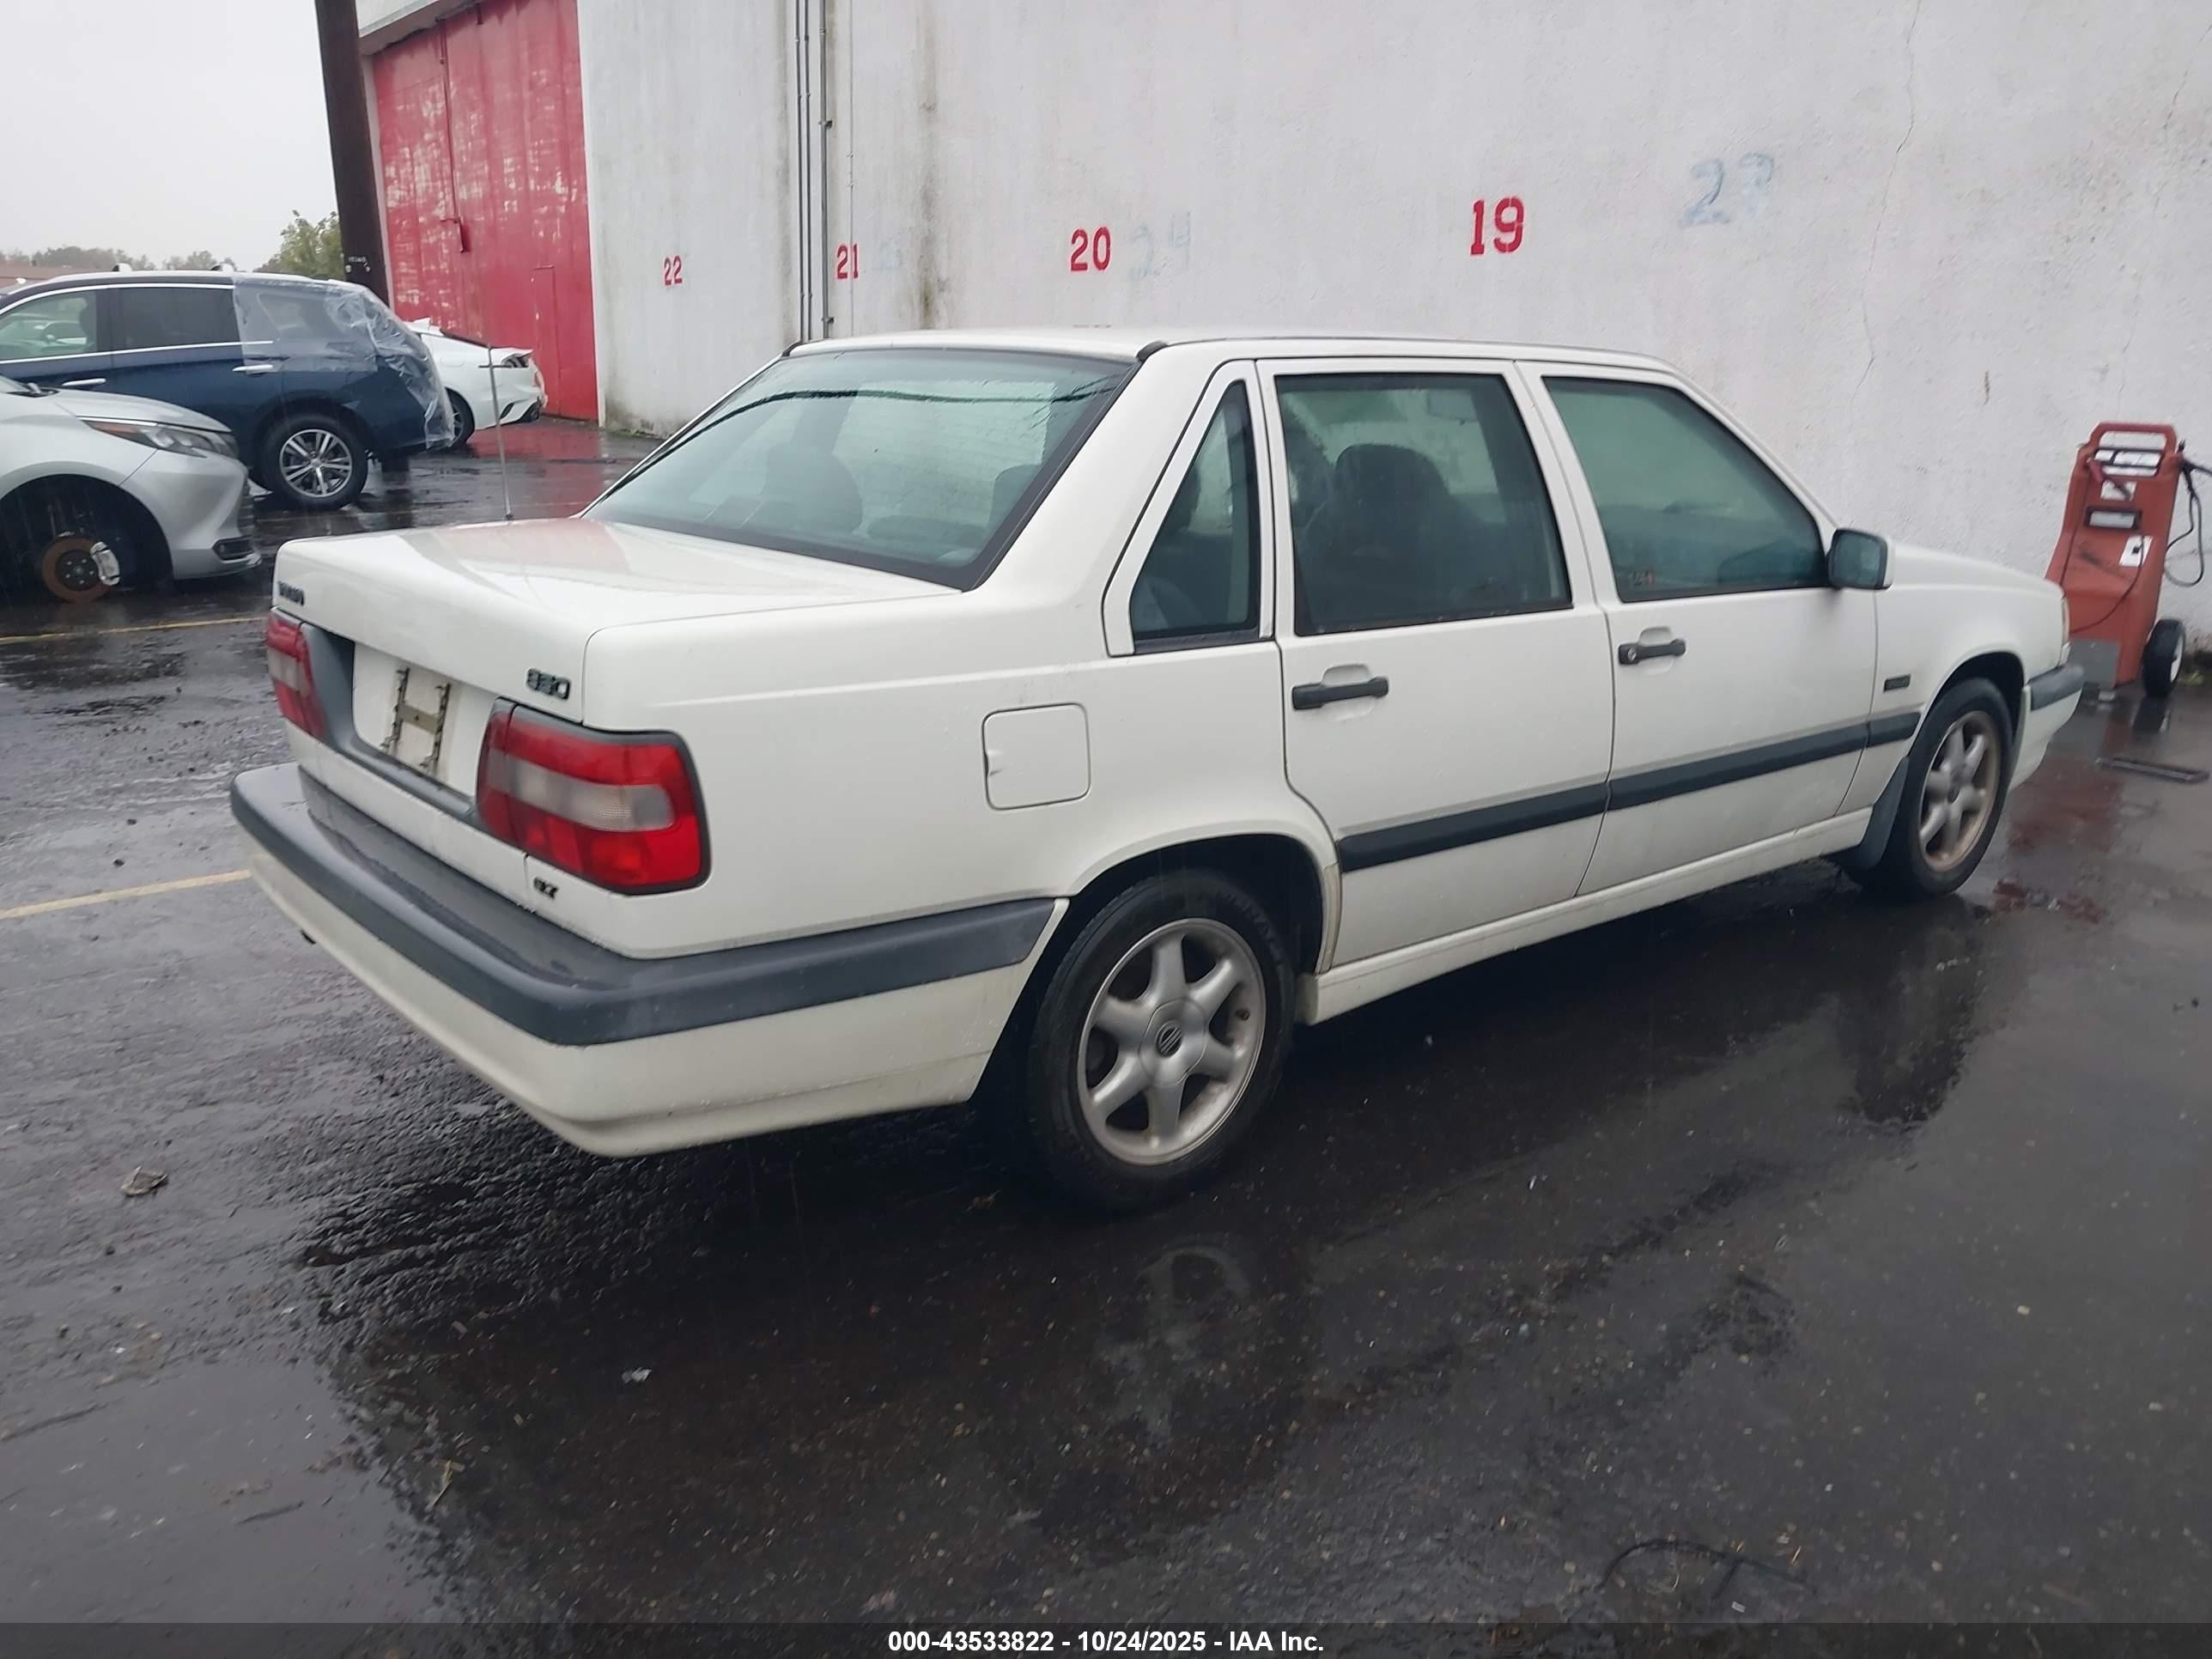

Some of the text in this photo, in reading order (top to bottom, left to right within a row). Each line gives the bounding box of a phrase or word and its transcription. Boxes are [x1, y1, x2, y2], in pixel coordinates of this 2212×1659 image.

[1470, 196, 1525, 256] 19
[836, 244, 859, 280] 21
[1070, 226, 1112, 272] 20
[664, 257, 683, 286] 22
